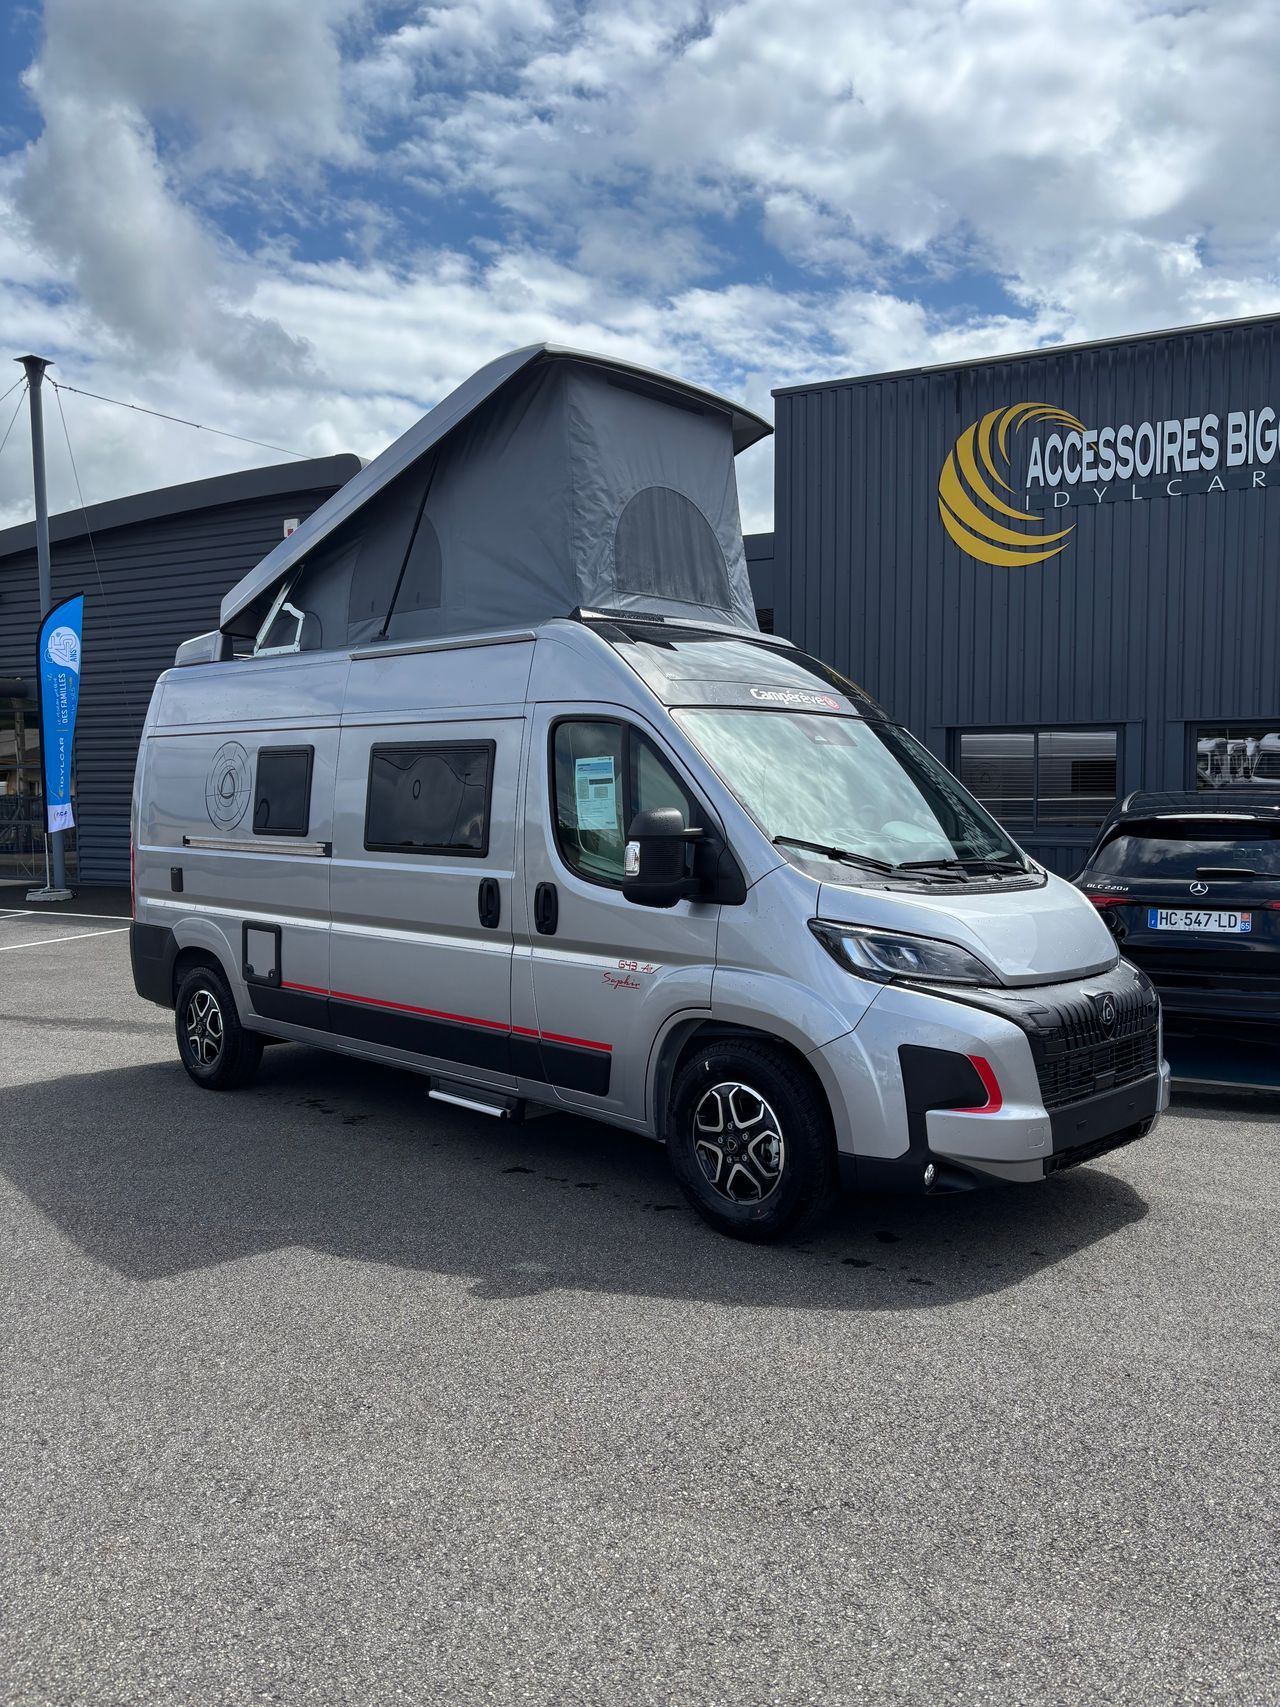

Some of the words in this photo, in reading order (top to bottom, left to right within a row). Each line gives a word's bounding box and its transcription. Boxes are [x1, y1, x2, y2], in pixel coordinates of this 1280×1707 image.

[1026, 413, 1219, 488] ACCESSOIRES
[1226, 406, 1280, 467] BIG
[1026, 471, 1266, 511] IDYLCAR
[69, 649, 78, 663] ANS
[749, 688, 826, 705] Campérève
[61, 709, 69, 724] DES
[1159, 911, 1238, 929] HC-547-LD
